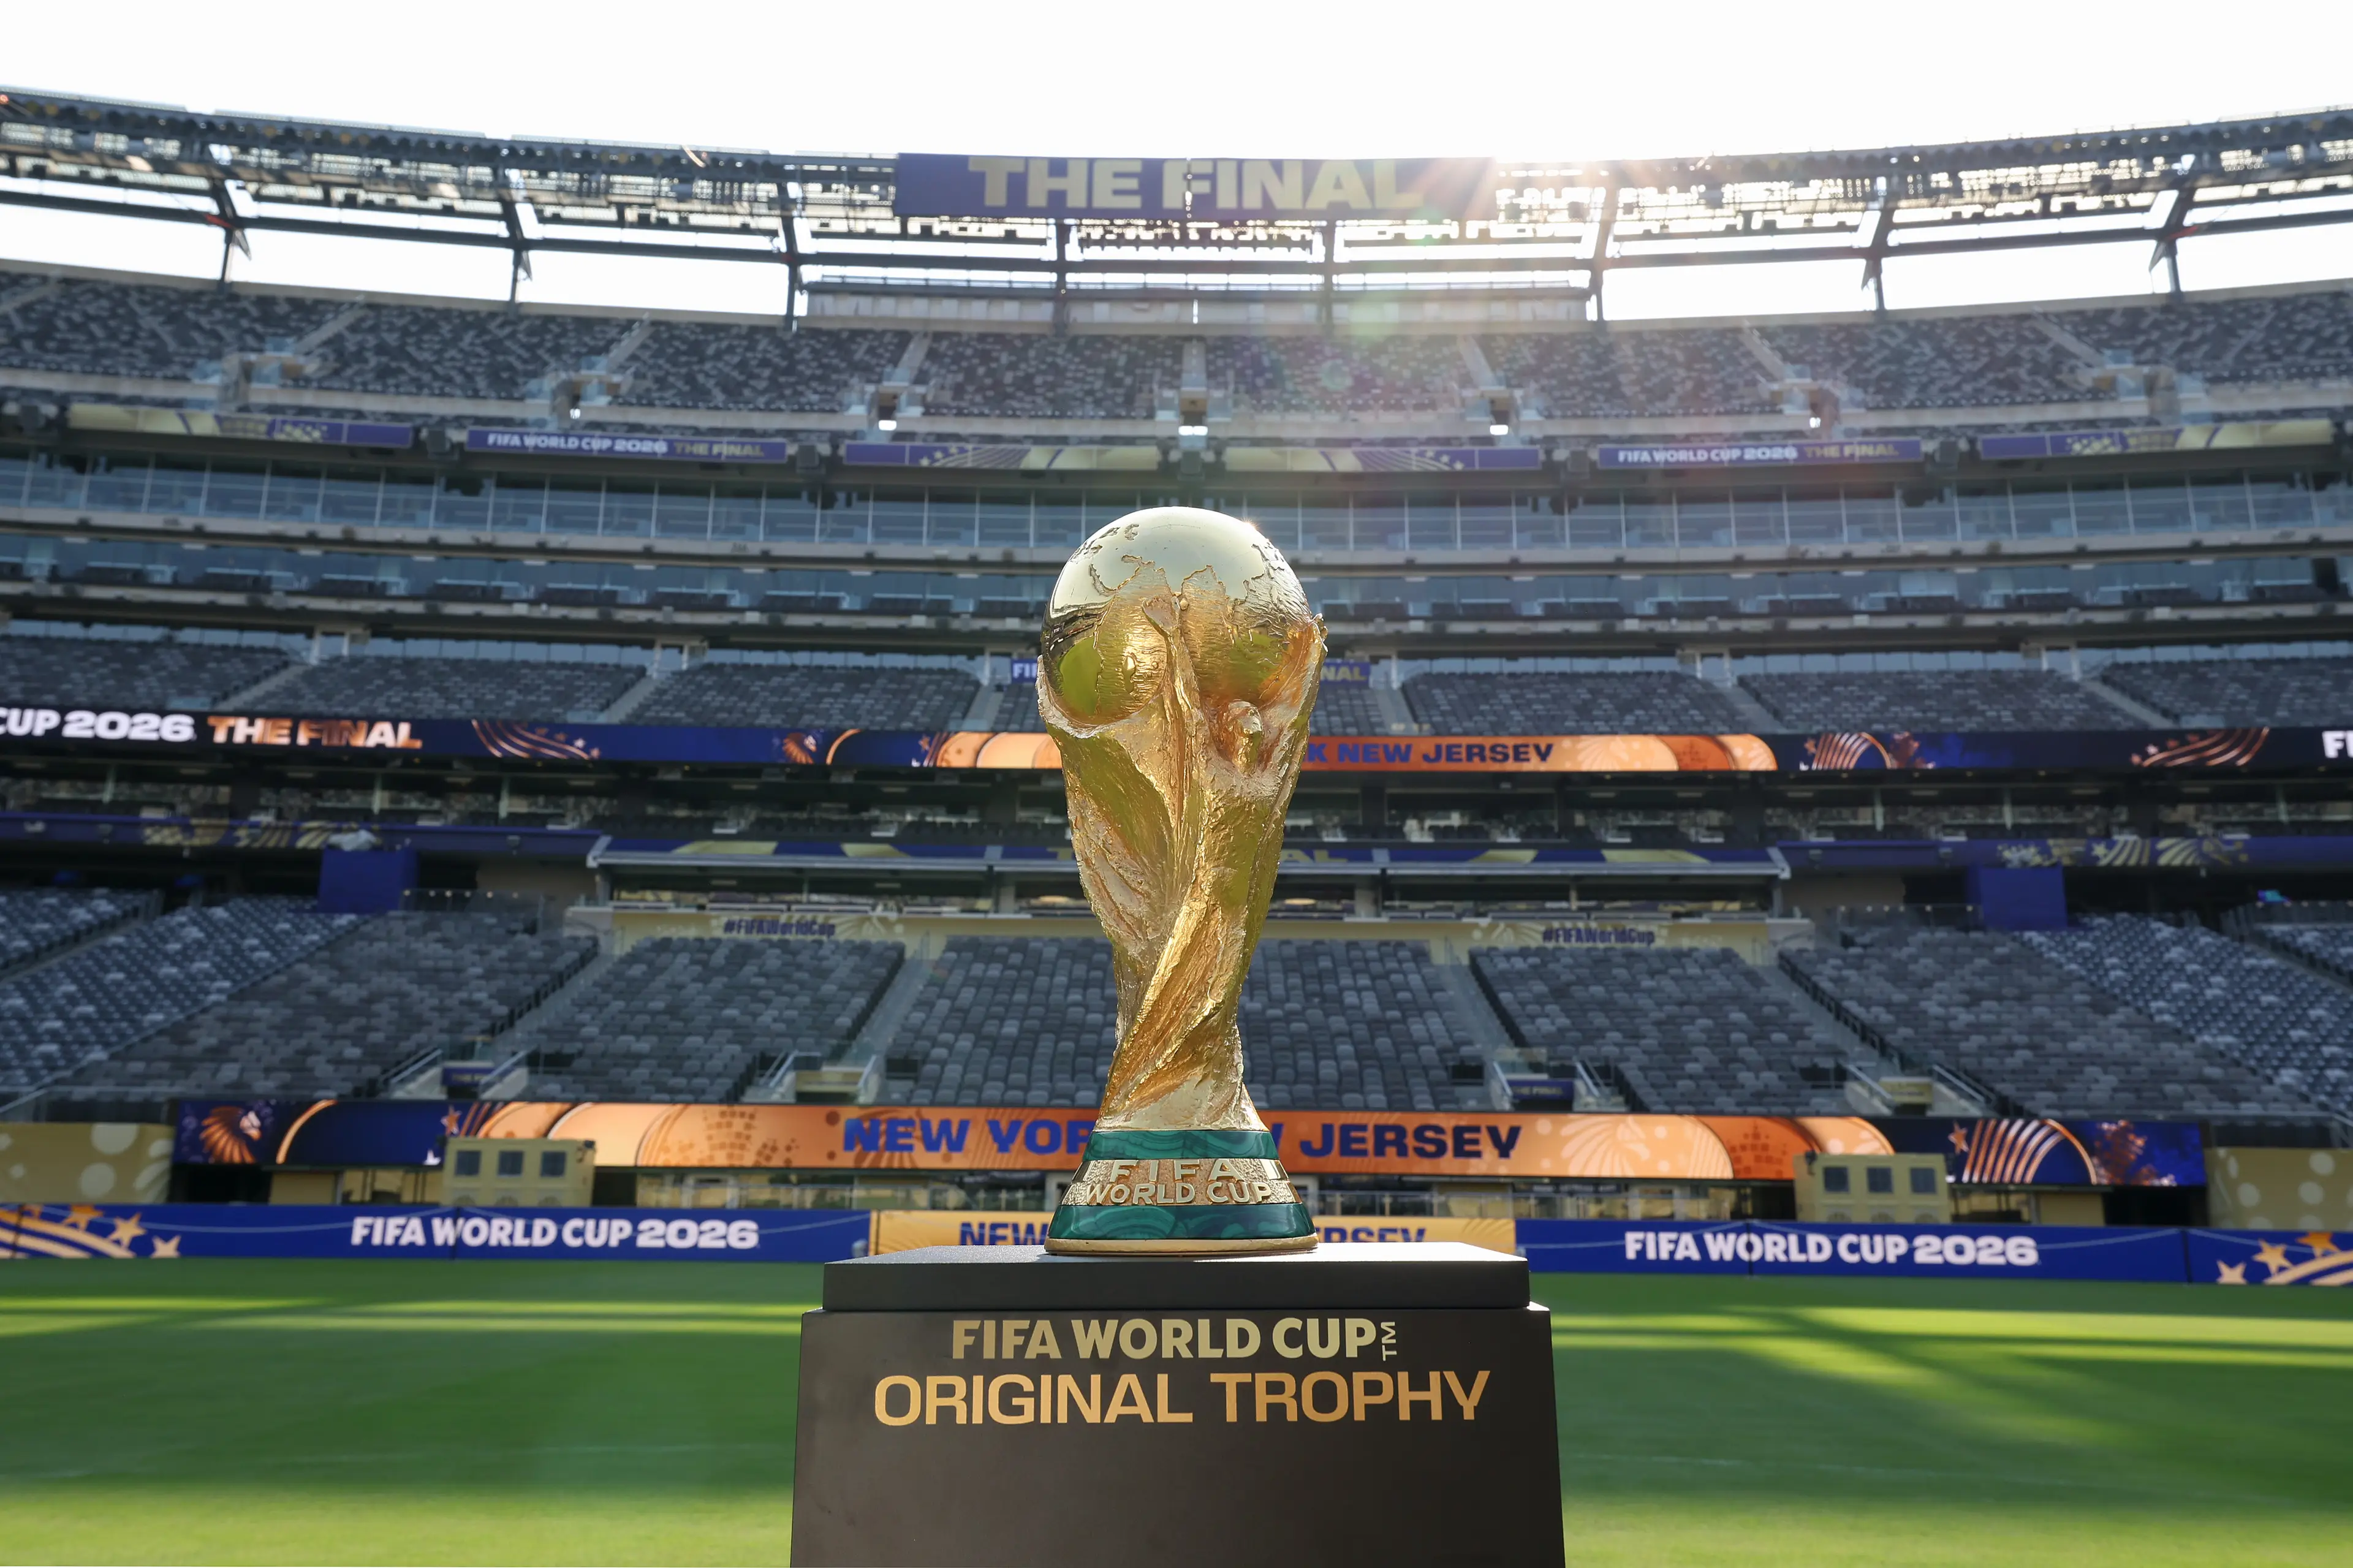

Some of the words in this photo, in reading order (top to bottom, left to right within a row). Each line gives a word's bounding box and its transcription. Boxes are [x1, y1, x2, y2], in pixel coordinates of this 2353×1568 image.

[968, 156, 1141, 209] THE
[1162, 158, 1425, 210] FINAL
[487, 433, 521, 447] FIFA
[522, 434, 579, 450] WORLD
[582, 436, 612, 450] CUP
[613, 439, 668, 454] 2026
[675, 442, 709, 455] THE
[711, 444, 765, 457] FINAL
[1618, 450, 1651, 463] FIFA
[1653, 448, 1708, 463] WORLD
[1710, 447, 1741, 461] CUP
[1743, 445, 1798, 460] 2026
[1803, 445, 1840, 458] THE
[1843, 444, 1900, 457] FINAL
[62, 710, 195, 743] 2026
[207, 715, 293, 745] THE
[296, 719, 423, 749] FINAL
[1338, 743, 1413, 763] NEW
[1422, 743, 1554, 763] JERSEY
[843, 1118, 970, 1154] NEW
[1300, 1123, 1522, 1159] JERSEY
[1108, 1159, 1244, 1183] FIFA
[1086, 1183, 1196, 1205] WORLD
[1207, 1182, 1272, 1203] CUP
[351, 1216, 425, 1246] FIFA
[431, 1218, 557, 1248] WORLD
[562, 1219, 632, 1248] CUP
[636, 1220, 760, 1249] 2026
[1624, 1232, 1700, 1260] FIFA
[1703, 1232, 1833, 1262] WORLD
[1838, 1233, 1908, 1264] CUP
[1913, 1235, 2039, 1266] 2026
[952, 1319, 1062, 1360] FIFA
[1071, 1318, 1261, 1359] WORLD
[1272, 1317, 1377, 1359] CUP
[875, 1372, 1194, 1426] ORIGINAL
[1210, 1369, 1491, 1422] TROPHY
